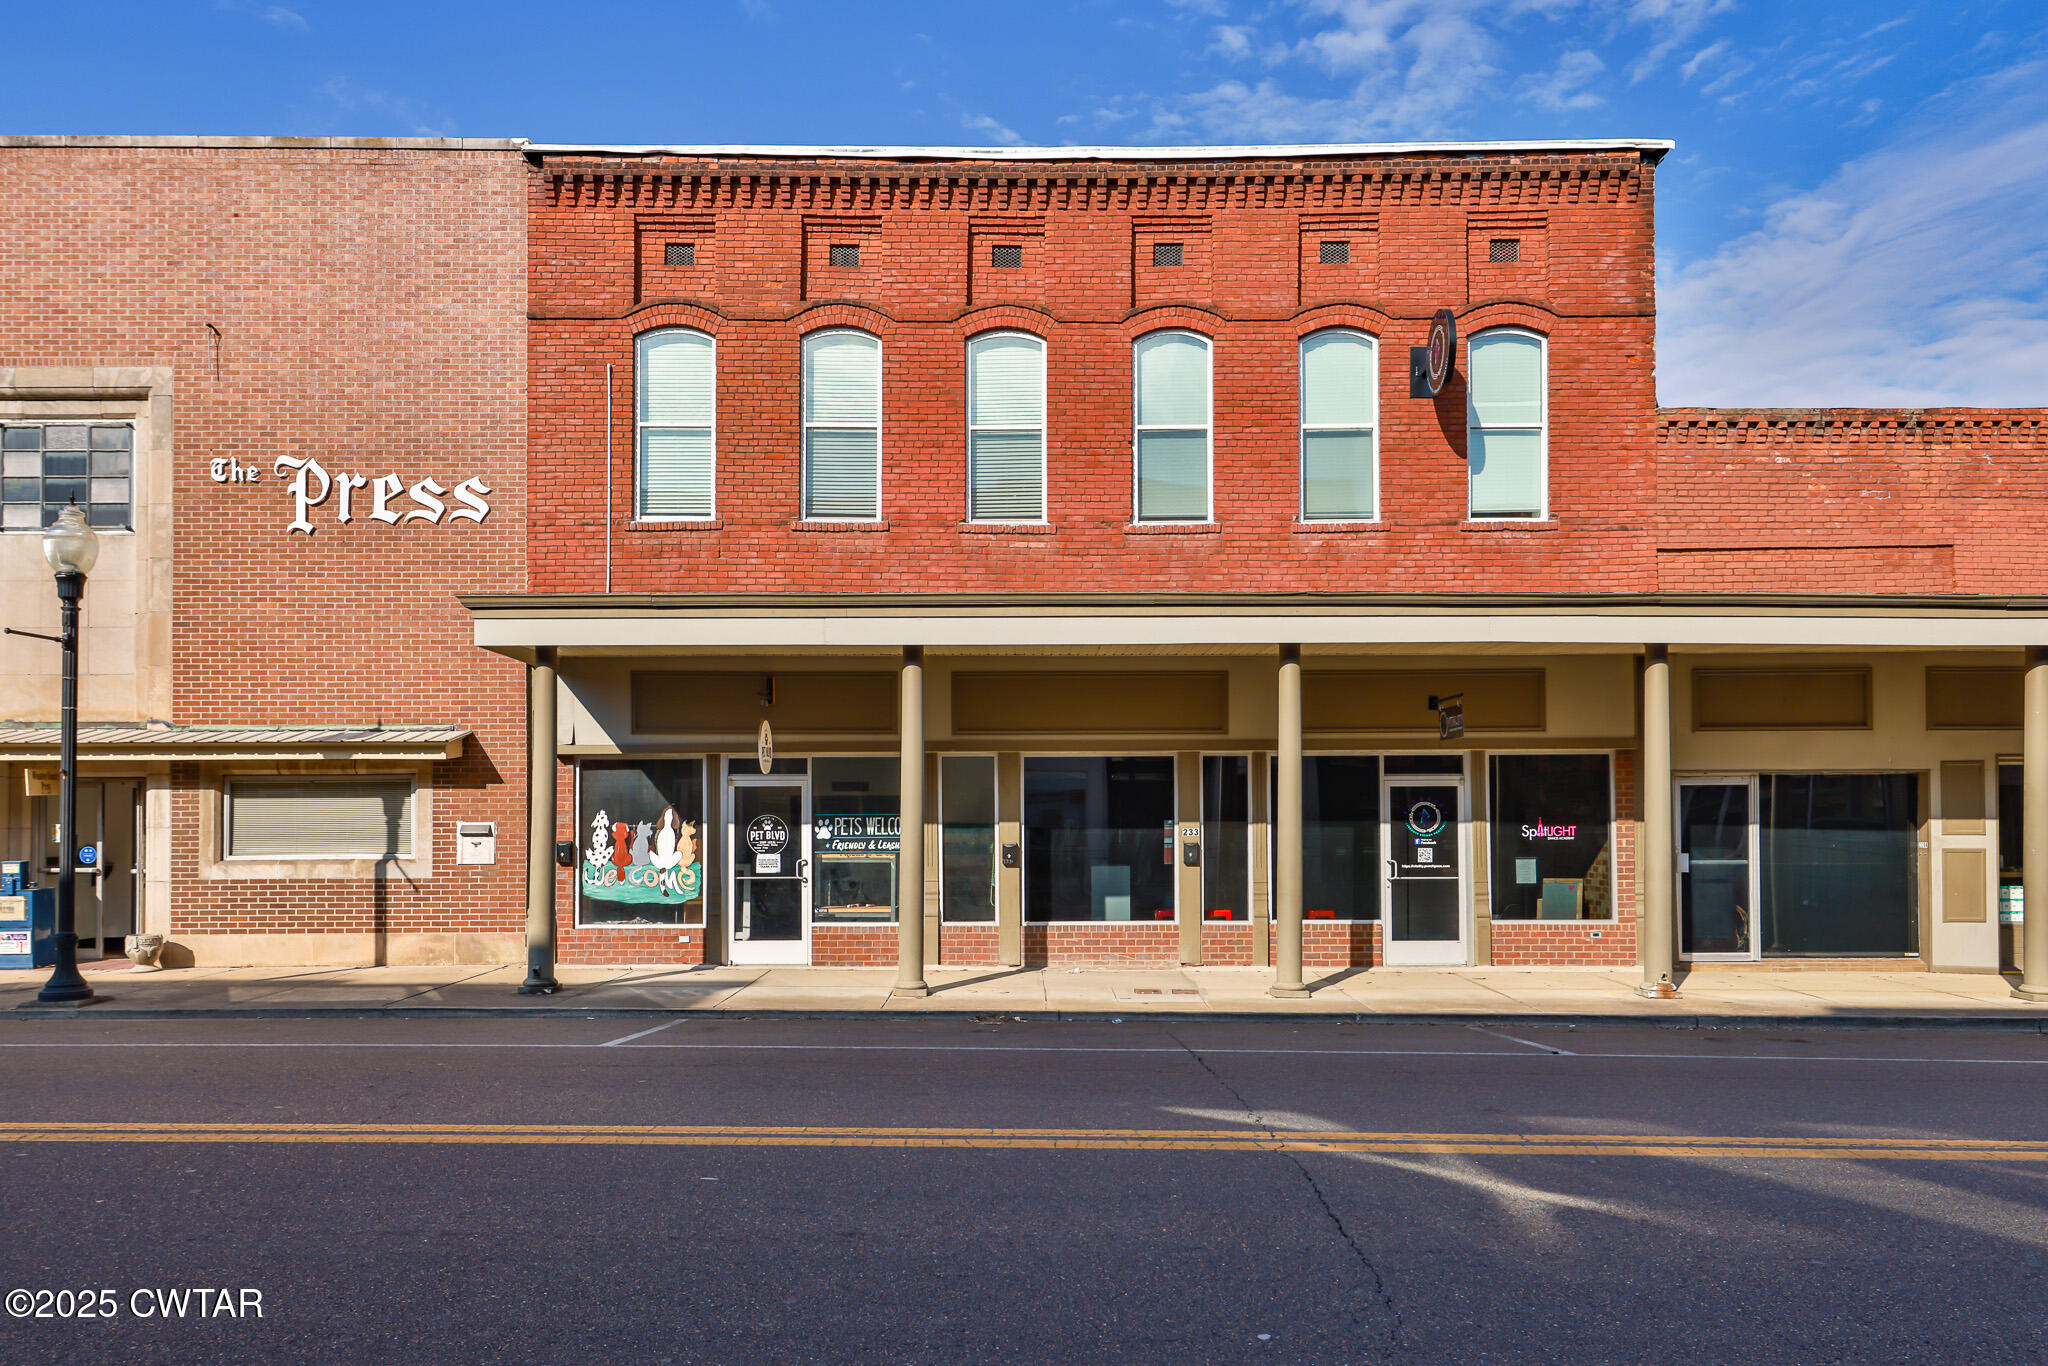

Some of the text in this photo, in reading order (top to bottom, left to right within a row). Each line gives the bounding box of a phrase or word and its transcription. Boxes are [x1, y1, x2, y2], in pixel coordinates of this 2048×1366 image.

[209, 455, 493, 535] The Press
[834, 817, 863, 836] PETS
[1182, 828, 1199, 836] 233
[750, 830, 786, 842] PET BLVD
[868, 840, 876, 850] &
